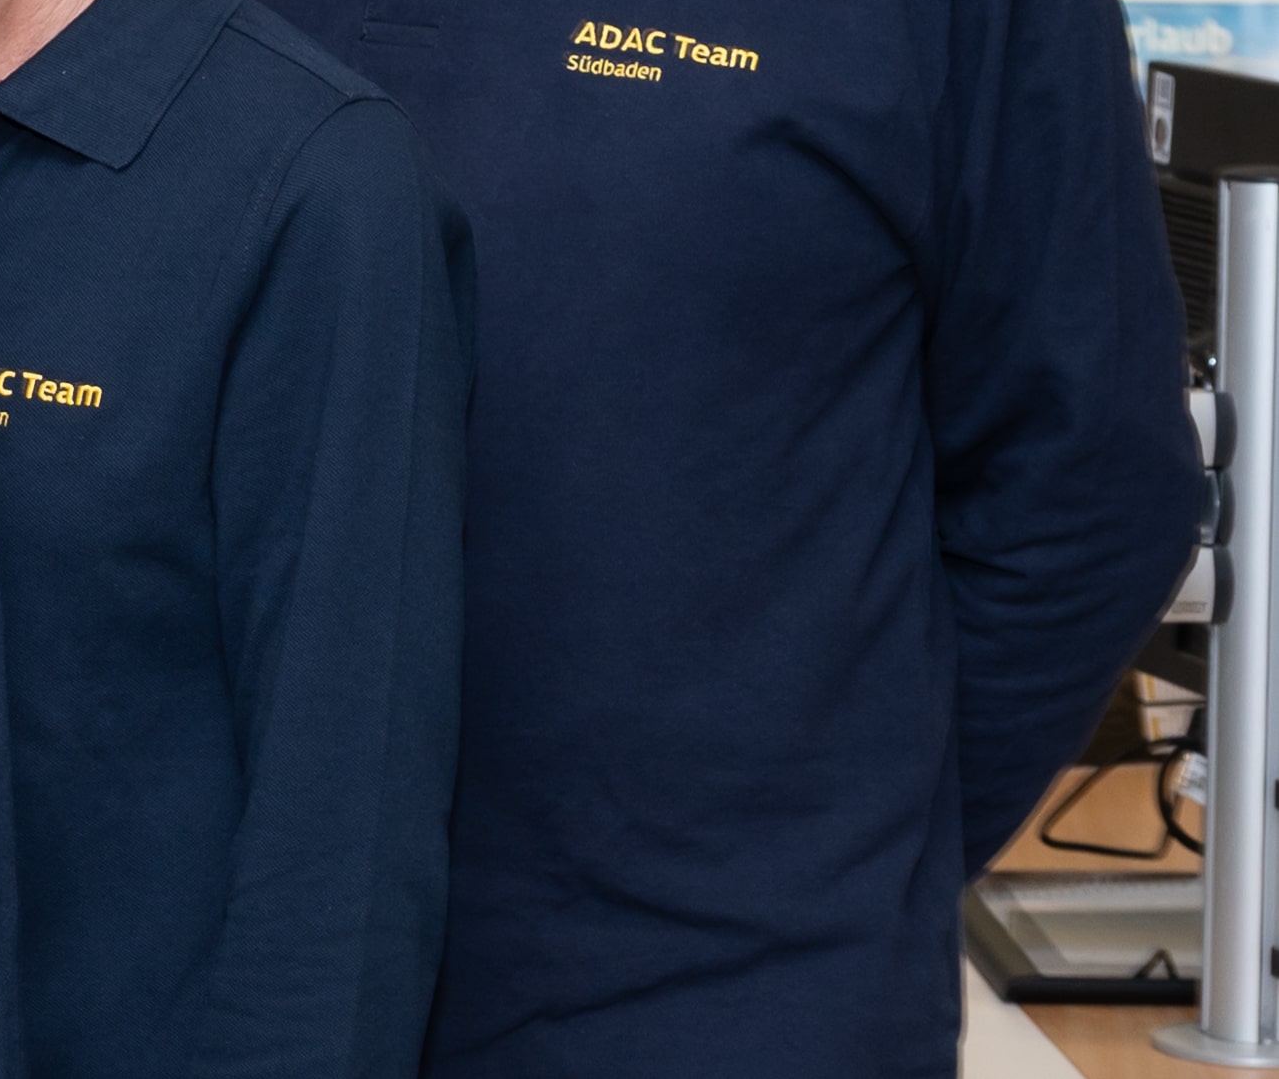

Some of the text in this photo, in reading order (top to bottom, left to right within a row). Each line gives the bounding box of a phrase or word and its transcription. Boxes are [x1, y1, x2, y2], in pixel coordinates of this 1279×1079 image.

[574, 21, 760, 72] ADAC Team
[566, 54, 662, 82] Südbaden
[22, 371, 103, 408] Team
